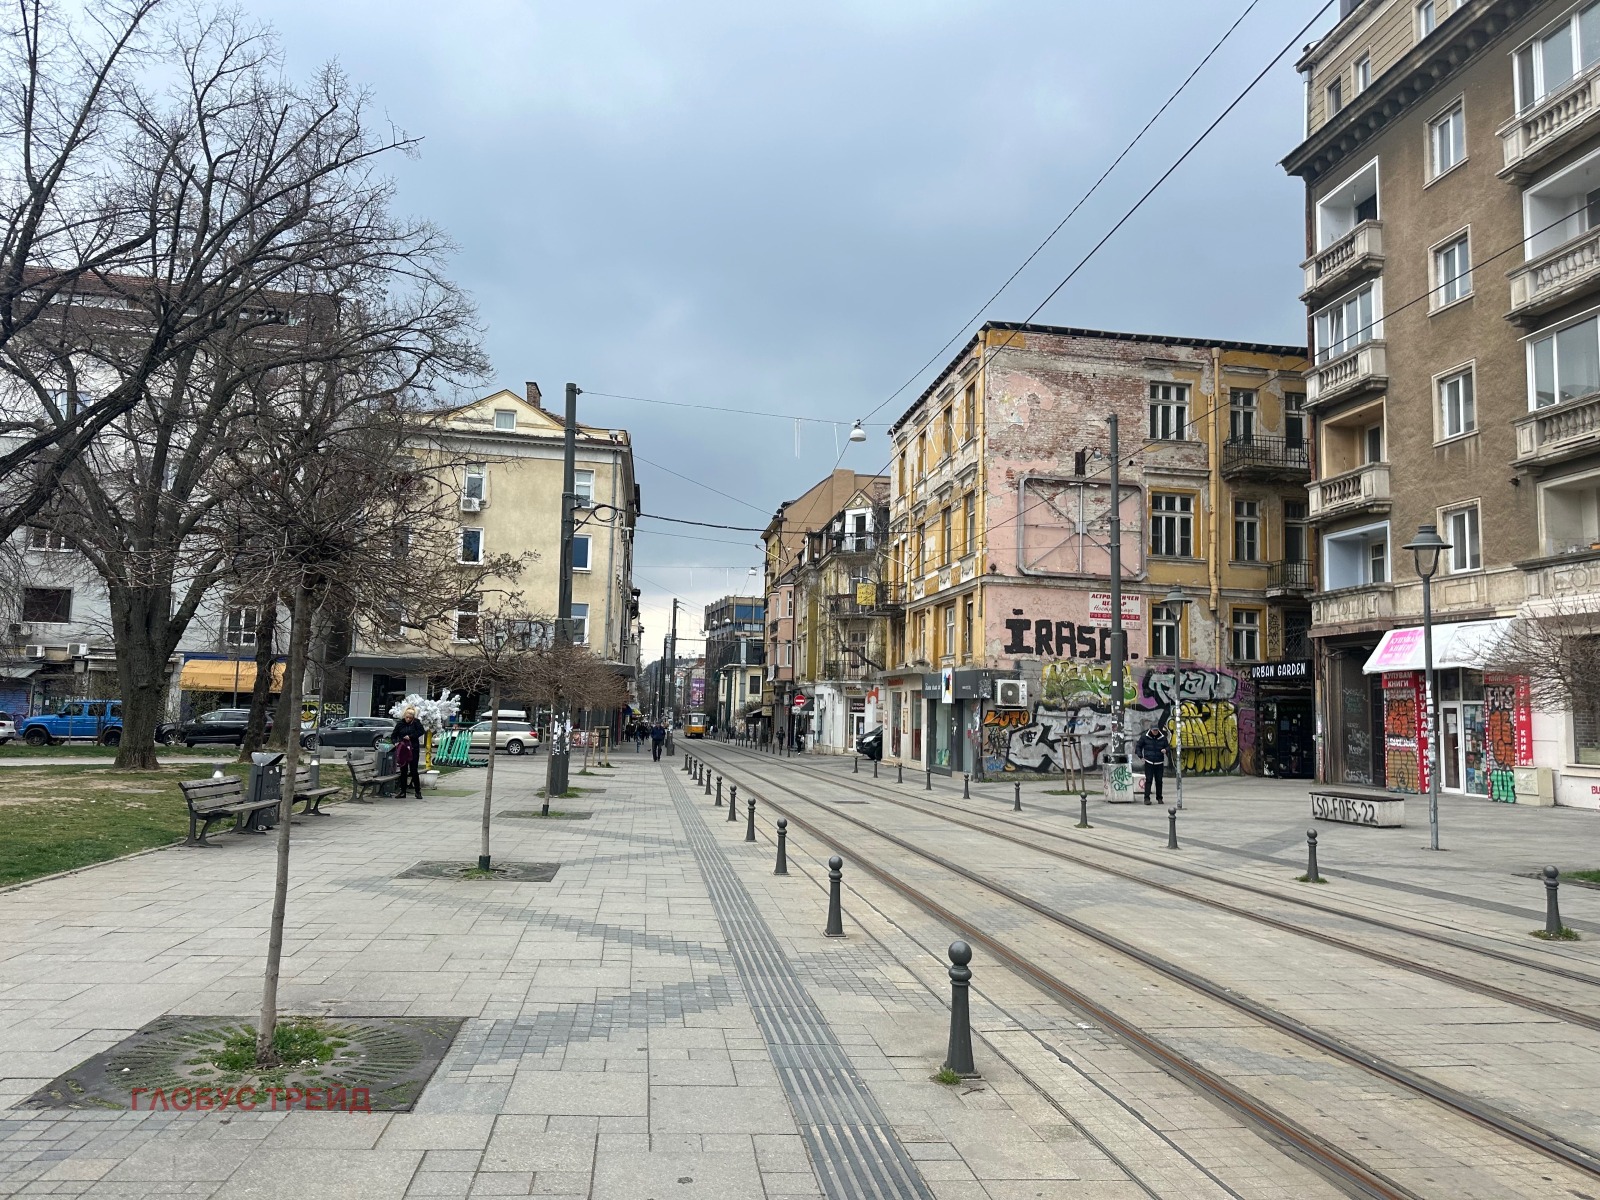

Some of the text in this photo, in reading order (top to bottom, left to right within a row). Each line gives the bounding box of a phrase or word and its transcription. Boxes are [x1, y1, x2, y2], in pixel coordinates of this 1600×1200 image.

[1251, 662, 1306, 679] URBAN GARDEN
[1387, 680, 1409, 688] КНИГИ
